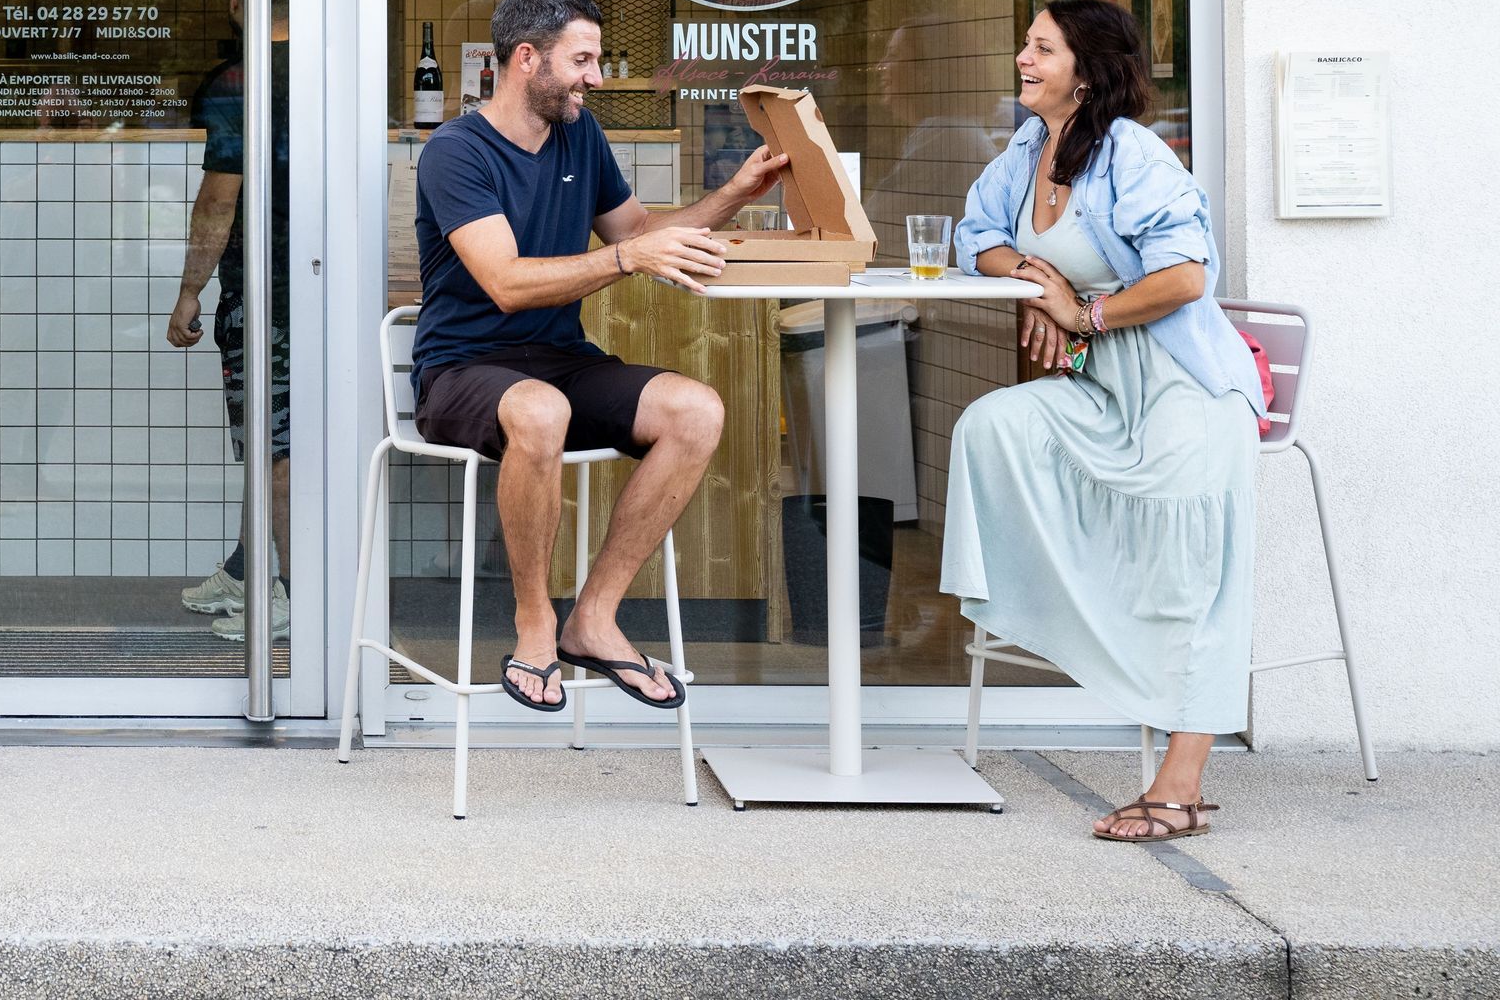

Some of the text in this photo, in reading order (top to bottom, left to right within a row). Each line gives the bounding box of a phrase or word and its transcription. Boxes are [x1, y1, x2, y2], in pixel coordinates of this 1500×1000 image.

[3, 5, 159, 21] Tél. 04 28 29 57 70
[96, 26, 171, 39] MIDI&SOIR
[673, 23, 817, 61] MUNSTER
[30, 52, 131, 61] www.basilic-and-co.com
[652, 51, 729, 93] Alsace
[743, 55, 839, 87] Lorraine
[0, 73, 161, 85] À EMPORTER EN LIVRAISON
[14, 88, 25, 96] AU
[27, 88, 52, 96] JEUDI
[55, 88, 81, 96] 11h30
[87, 88, 112, 96] 14h00
[119, 88, 144, 96] 18h00
[150, 88, 176, 96] 22h00
[18, 99, 30, 107] AU
[31, 99, 65, 107] SAMEDI
[67, 99, 93, 107] 11h30
[99, 99, 125, 107] 14h30
[131, 99, 156, 107] 18h00
[162, 99, 188, 107] 22h30
[45, 109, 70, 117] 11h30
[76, 109, 102, 117] 14h00
[108, 109, 134, 117] 18h00
[140, 109, 166, 117] 22h00
